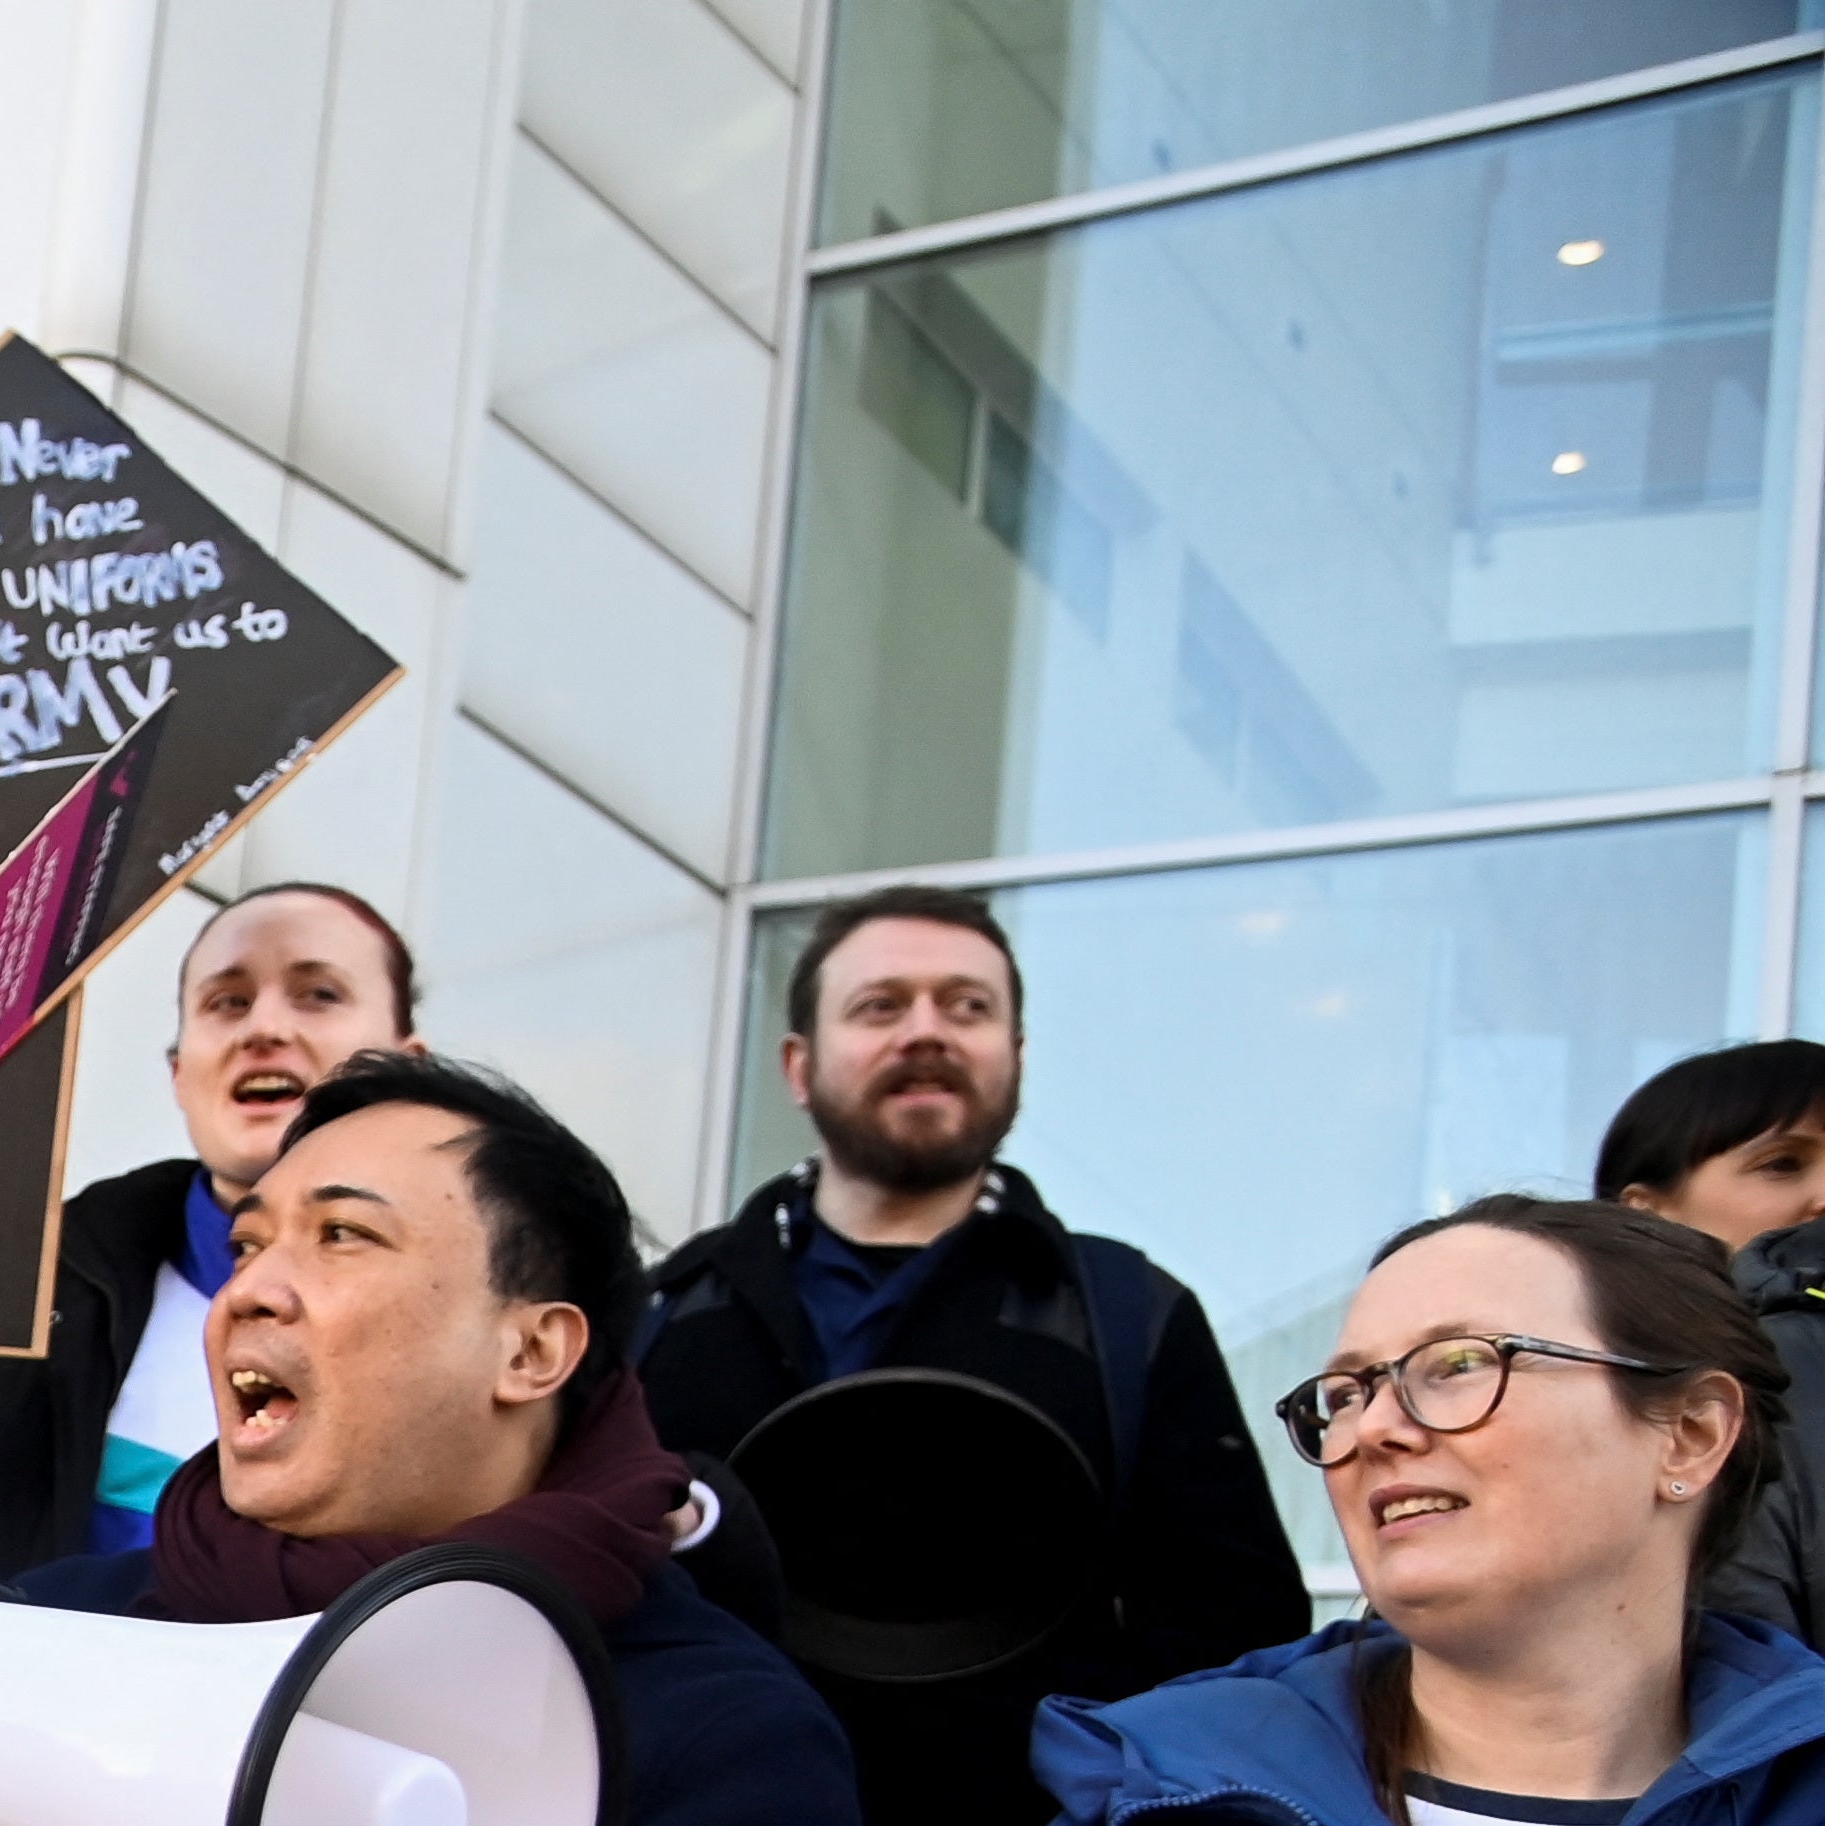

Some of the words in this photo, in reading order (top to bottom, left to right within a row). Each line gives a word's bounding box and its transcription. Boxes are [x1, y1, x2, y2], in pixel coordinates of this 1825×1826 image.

[31, 495, 145, 546] have
[0, 538, 226, 618] UNIFORMS
[172, 615, 229, 651] us
[231, 600, 290, 643] to
